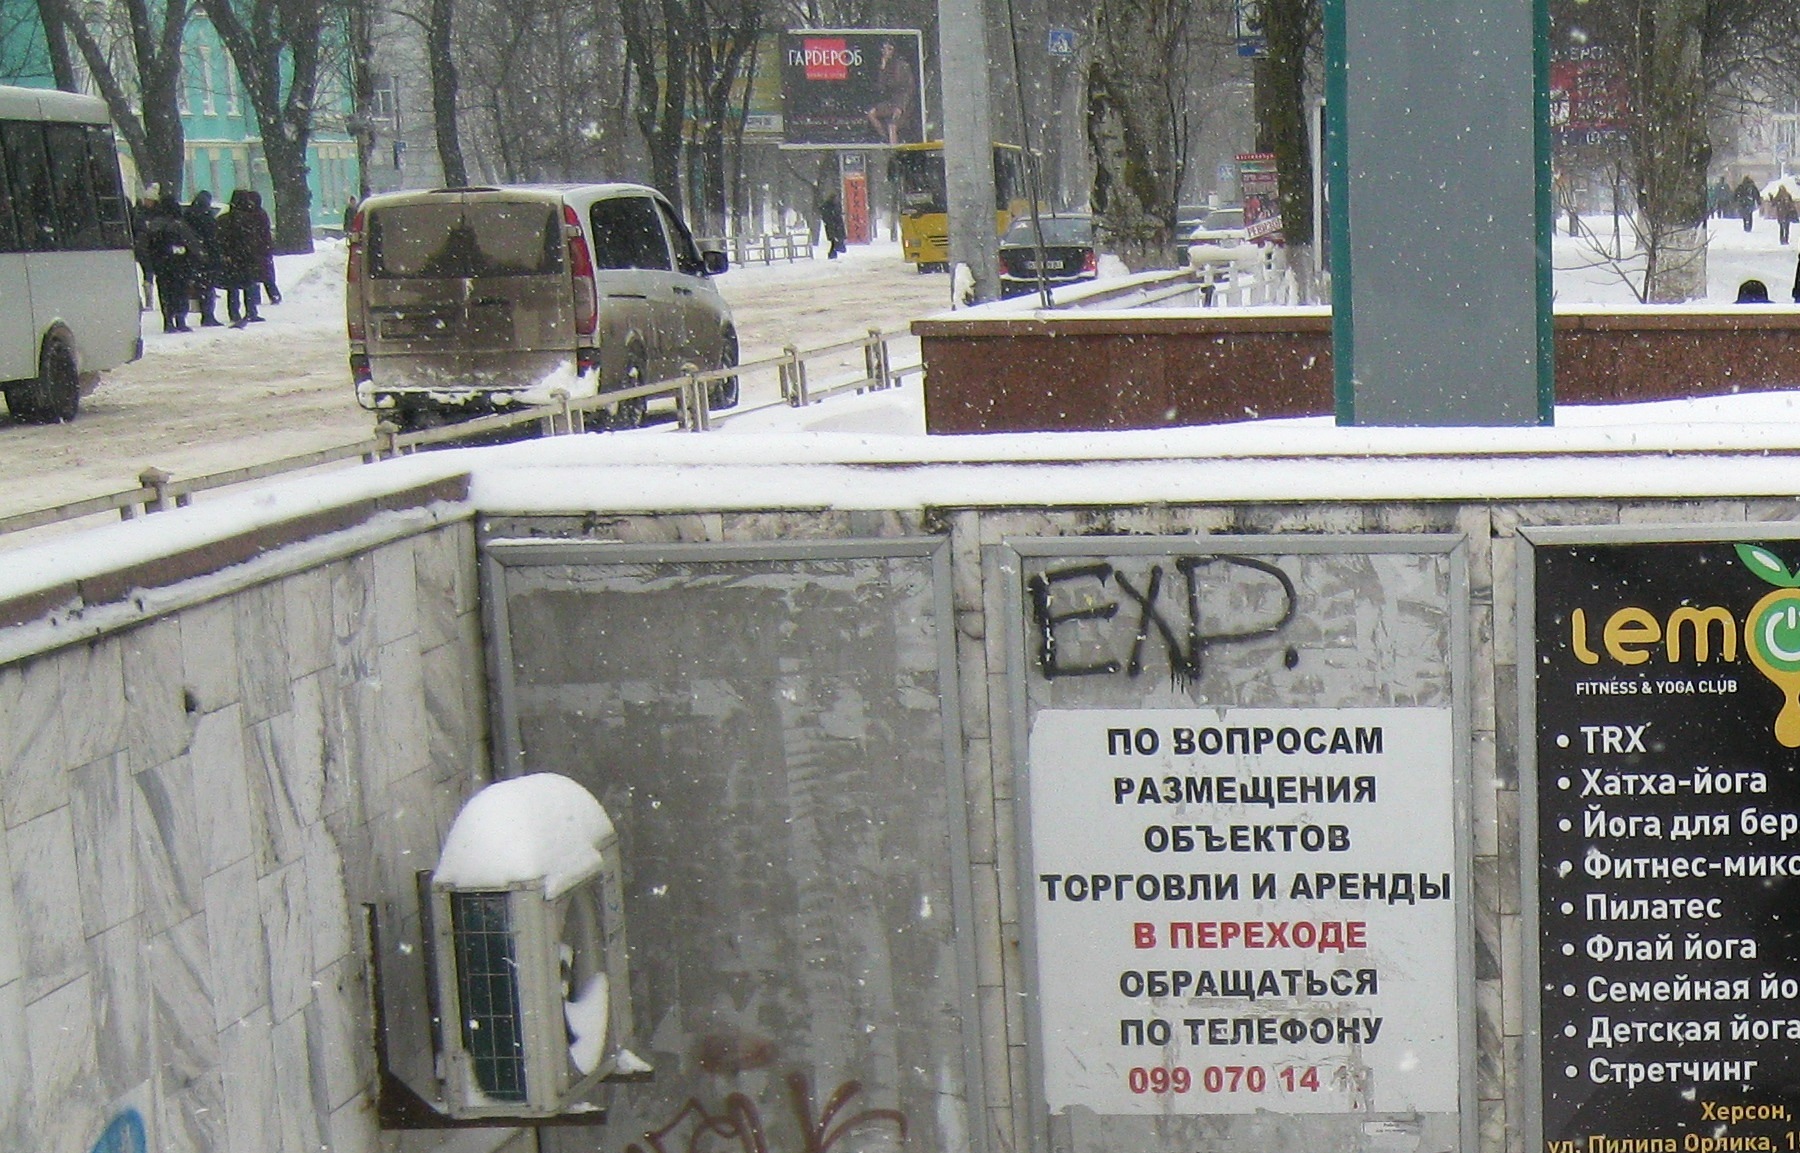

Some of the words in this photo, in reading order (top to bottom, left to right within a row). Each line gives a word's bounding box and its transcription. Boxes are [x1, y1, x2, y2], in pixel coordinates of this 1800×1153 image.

[788, 49, 862, 66] ГАРДЕРОБ
[1576, 681, 1638, 695] FITNESS
[1642, 680, 1653, 694] &
[1657, 681, 1695, 694] YOGA
[1698, 679, 1738, 694] CLUB
[1107, 728, 1159, 755] ПО
[1173, 727, 1383, 755] ВОПРОСАМ
[1580, 725, 1646, 754] TRX
[1114, 776, 1376, 809] РАЗМЕЩЕНИЯ
[1580, 766, 1767, 796] Хатха-йога
[1583, 804, 1661, 838] Йога
[1670, 812, 1730, 841] для
[1144, 825, 1351, 853] ОБЪЕКТОВ
[1040, 873, 1238, 901] ТОРГОВЛИ
[1253, 873, 1276, 900] И
[1290, 873, 1451, 905] АРЕНДЫ
[1585, 893, 1722, 921] Пилатес
[1134, 922, 1157, 949] В
[1170, 921, 1367, 954] ПЕРЕХОДЕ
[1586, 933, 1673, 962] Флай
[1684, 933, 1757, 960] йога
[1120, 968, 1378, 1001] ОБРАЩАТЬСЯ
[1587, 973, 1750, 1002] Семейная
[1121, 1019, 1172, 1046] ПО
[1184, 1017, 1383, 1046] ТЕЛЕФОНУ
[1587, 1017, 1720, 1049] Детская
[1129, 1067, 1191, 1094] 099
[1204, 1066, 1266, 1093] 070
[1279, 1066, 1320, 1093] 14
[1589, 1057, 1758, 1088] Стретчинг
[1701, 1100, 1792, 1125] Херсон,
